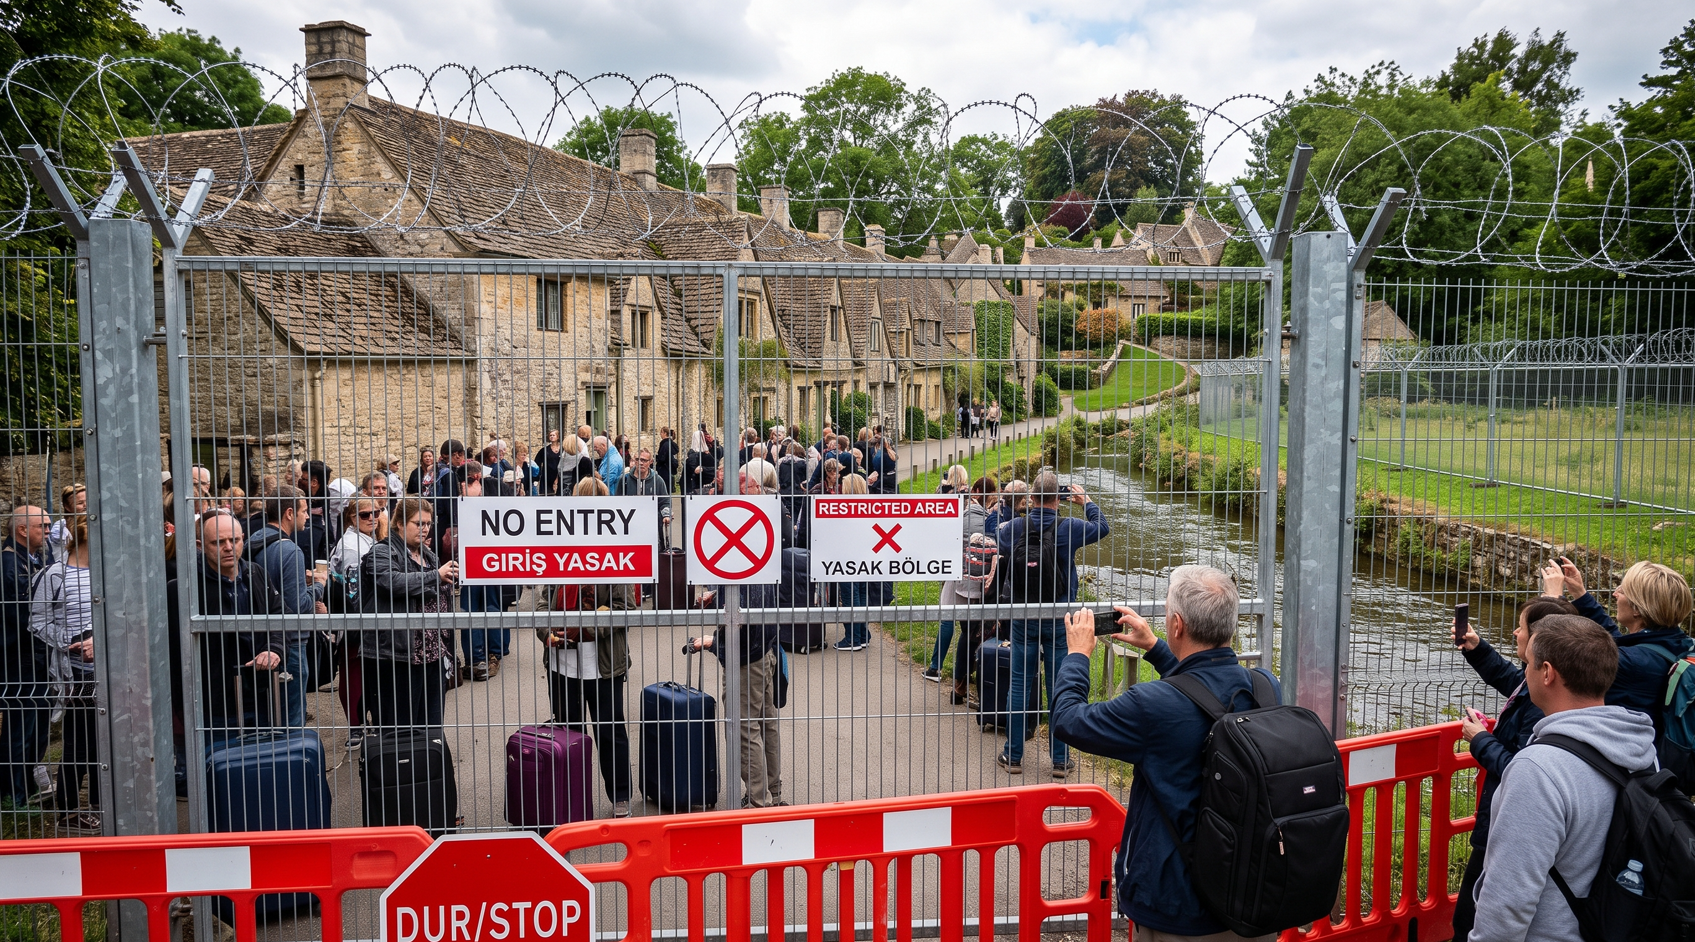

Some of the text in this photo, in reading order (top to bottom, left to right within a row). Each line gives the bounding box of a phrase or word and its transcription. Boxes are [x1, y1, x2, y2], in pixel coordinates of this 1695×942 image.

[481, 508, 637, 536] NO ENTRY
[819, 502, 956, 515] RESTRICTED AREA
[481, 548, 636, 576] GIRİŞ YASAK
[821, 557, 952, 576] YASAK BÖLGE
[396, 899, 582, 942] DUR/STOP
